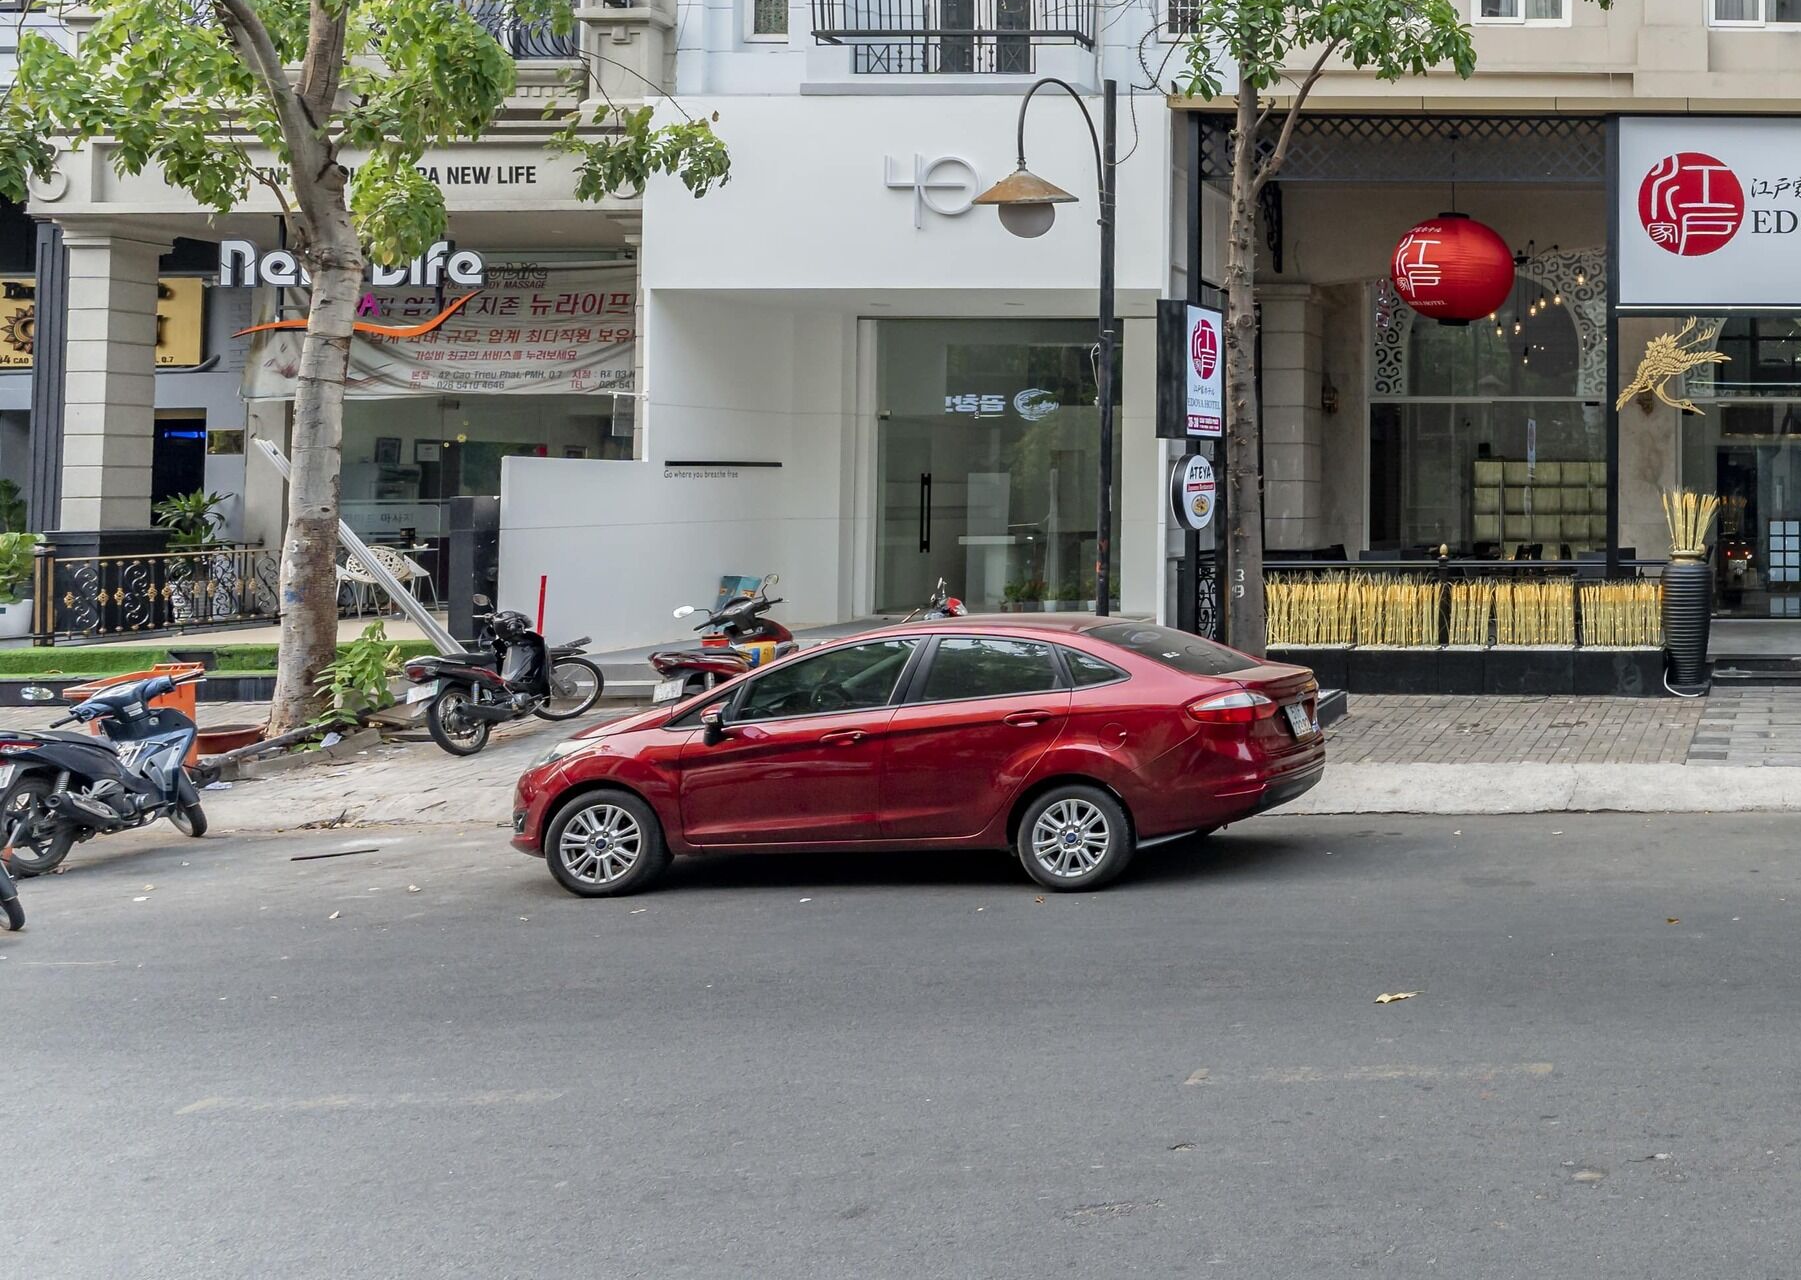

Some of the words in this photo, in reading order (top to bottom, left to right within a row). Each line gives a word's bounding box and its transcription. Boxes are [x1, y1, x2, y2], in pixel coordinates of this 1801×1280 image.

[446, 166, 491, 184] NEW
[497, 165, 537, 184] LIFE
[503, 280, 546, 289] MASSAGE
[476, 295, 521, 316] 지존
[529, 292, 632, 317] 뉴라이프
[488, 329, 522, 345] 업계
[528, 328, 594, 345] 최다직원
[13, 356, 30, 365] CAO
[452, 370, 472, 380] Cao
[473, 370, 497, 380] Trieu
[1204, 399, 1221, 410] HOTEL
[663, 469, 673, 479] Go
[674, 470, 692, 478] where
[692, 471, 703, 480] you
[704, 470, 726, 478] breathe
[727, 470, 739, 478] free
[1189, 466, 1212, 480] ATEYA
